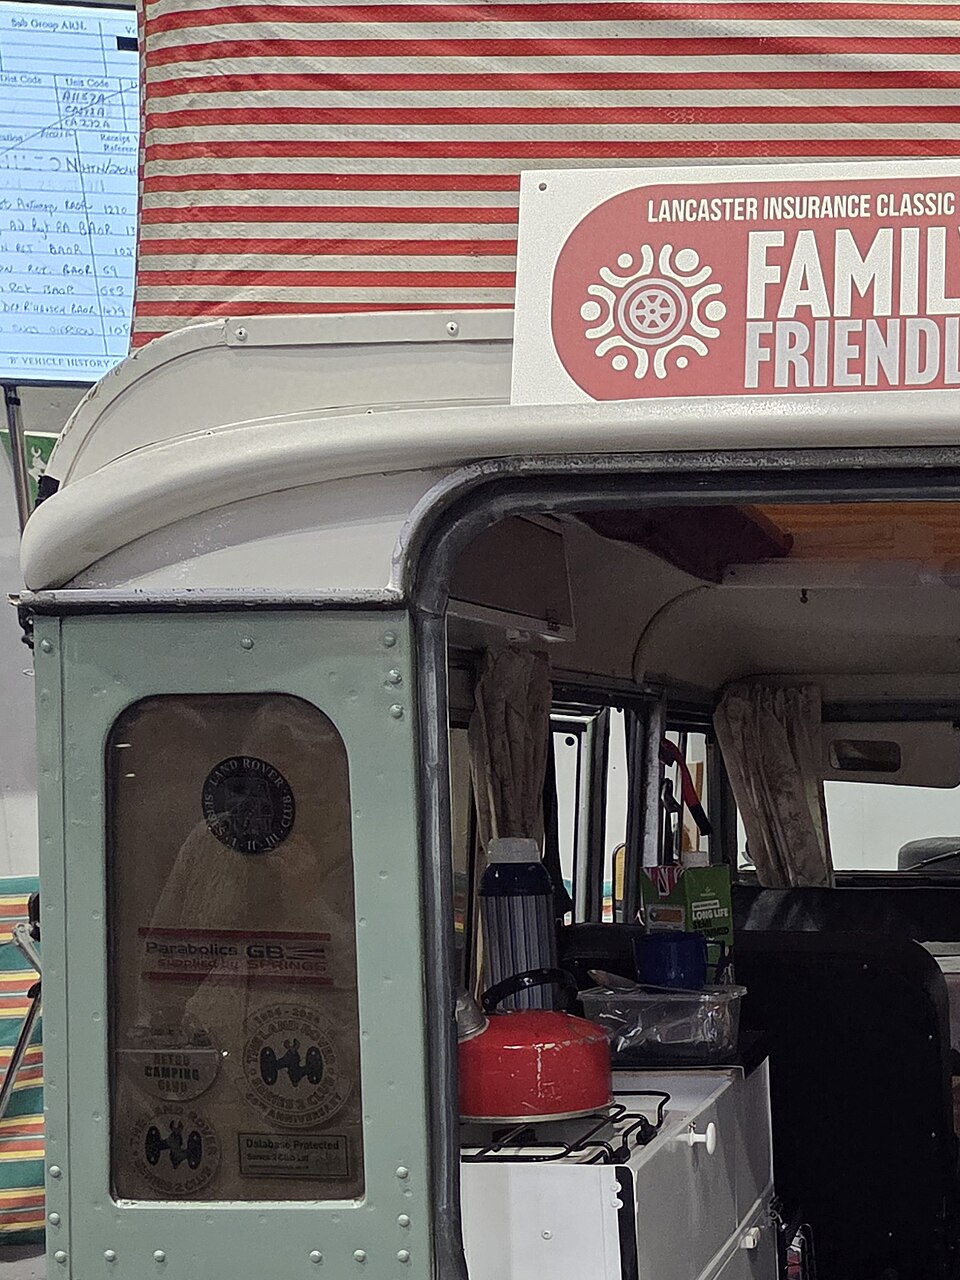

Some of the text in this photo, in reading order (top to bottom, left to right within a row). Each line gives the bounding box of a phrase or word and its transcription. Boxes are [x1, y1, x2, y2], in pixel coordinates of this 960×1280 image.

[647, 199, 758, 223] LANCASTER
[762, 195, 871, 221] INSURANCE
[876, 192, 955, 218] CLASSIC
[21, 357, 66, 367] VEHICLE
[67, 358, 110, 368] HISTORY
[208, 757, 284, 789] LAND ROVER
[281, 795, 292, 828] CLUB
[692, 908, 729, 921] LONG LIFE
[146, 941, 285, 959] Parabolics GB
[246, 960, 327, 972] SPRINGS
[260, 1019, 299, 1039] LAND
[301, 1023, 336, 1065] ROVER
[144, 1066, 200, 1081] CAMPING
[267, 1091, 342, 1124] ANNIVERSARY
[246, 1138, 340, 1151] Database Protected
